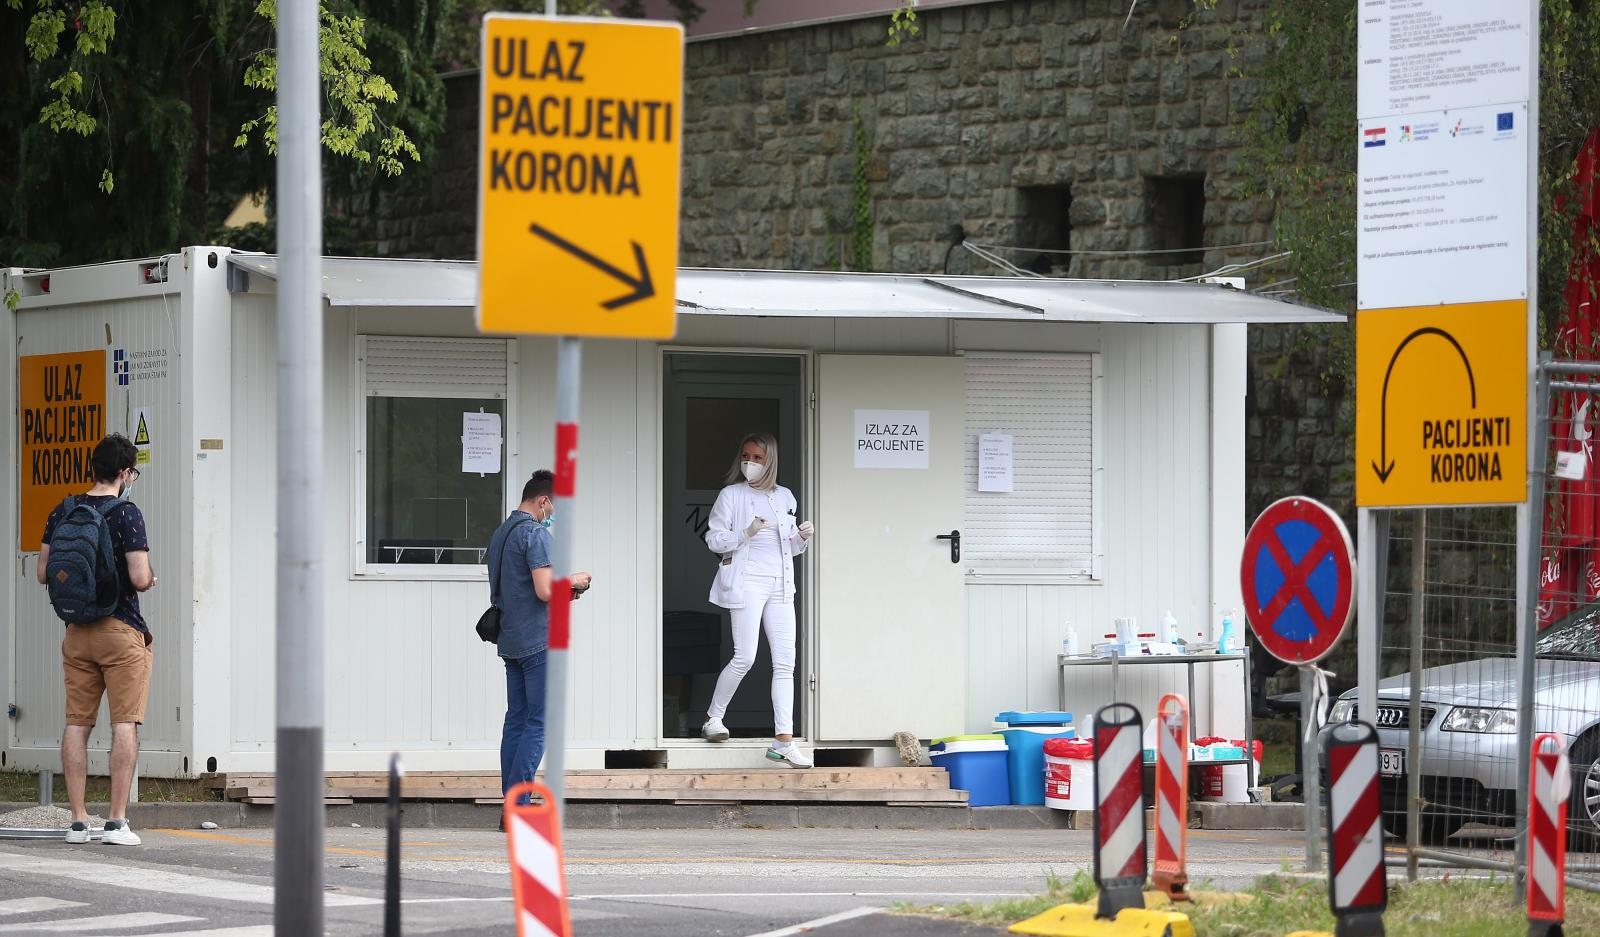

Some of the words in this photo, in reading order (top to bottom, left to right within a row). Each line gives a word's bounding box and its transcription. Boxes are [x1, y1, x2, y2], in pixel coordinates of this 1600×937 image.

[492, 37, 586, 82] ULAZ
[491, 93, 673, 143] PACIJENTI
[490, 148, 640, 197] KORONA
[44, 363, 82, 402] ULAZ
[24, 404, 102, 445] PACIJENTI
[865, 424, 899, 435] IZLAZ
[902, 424, 918, 436] ZA
[1423, 417, 1510, 449] PACIJENTI
[858, 439, 924, 451] PACIJENTE
[32, 447, 95, 485] KORONA
[1431, 452, 1502, 483] KORONA
